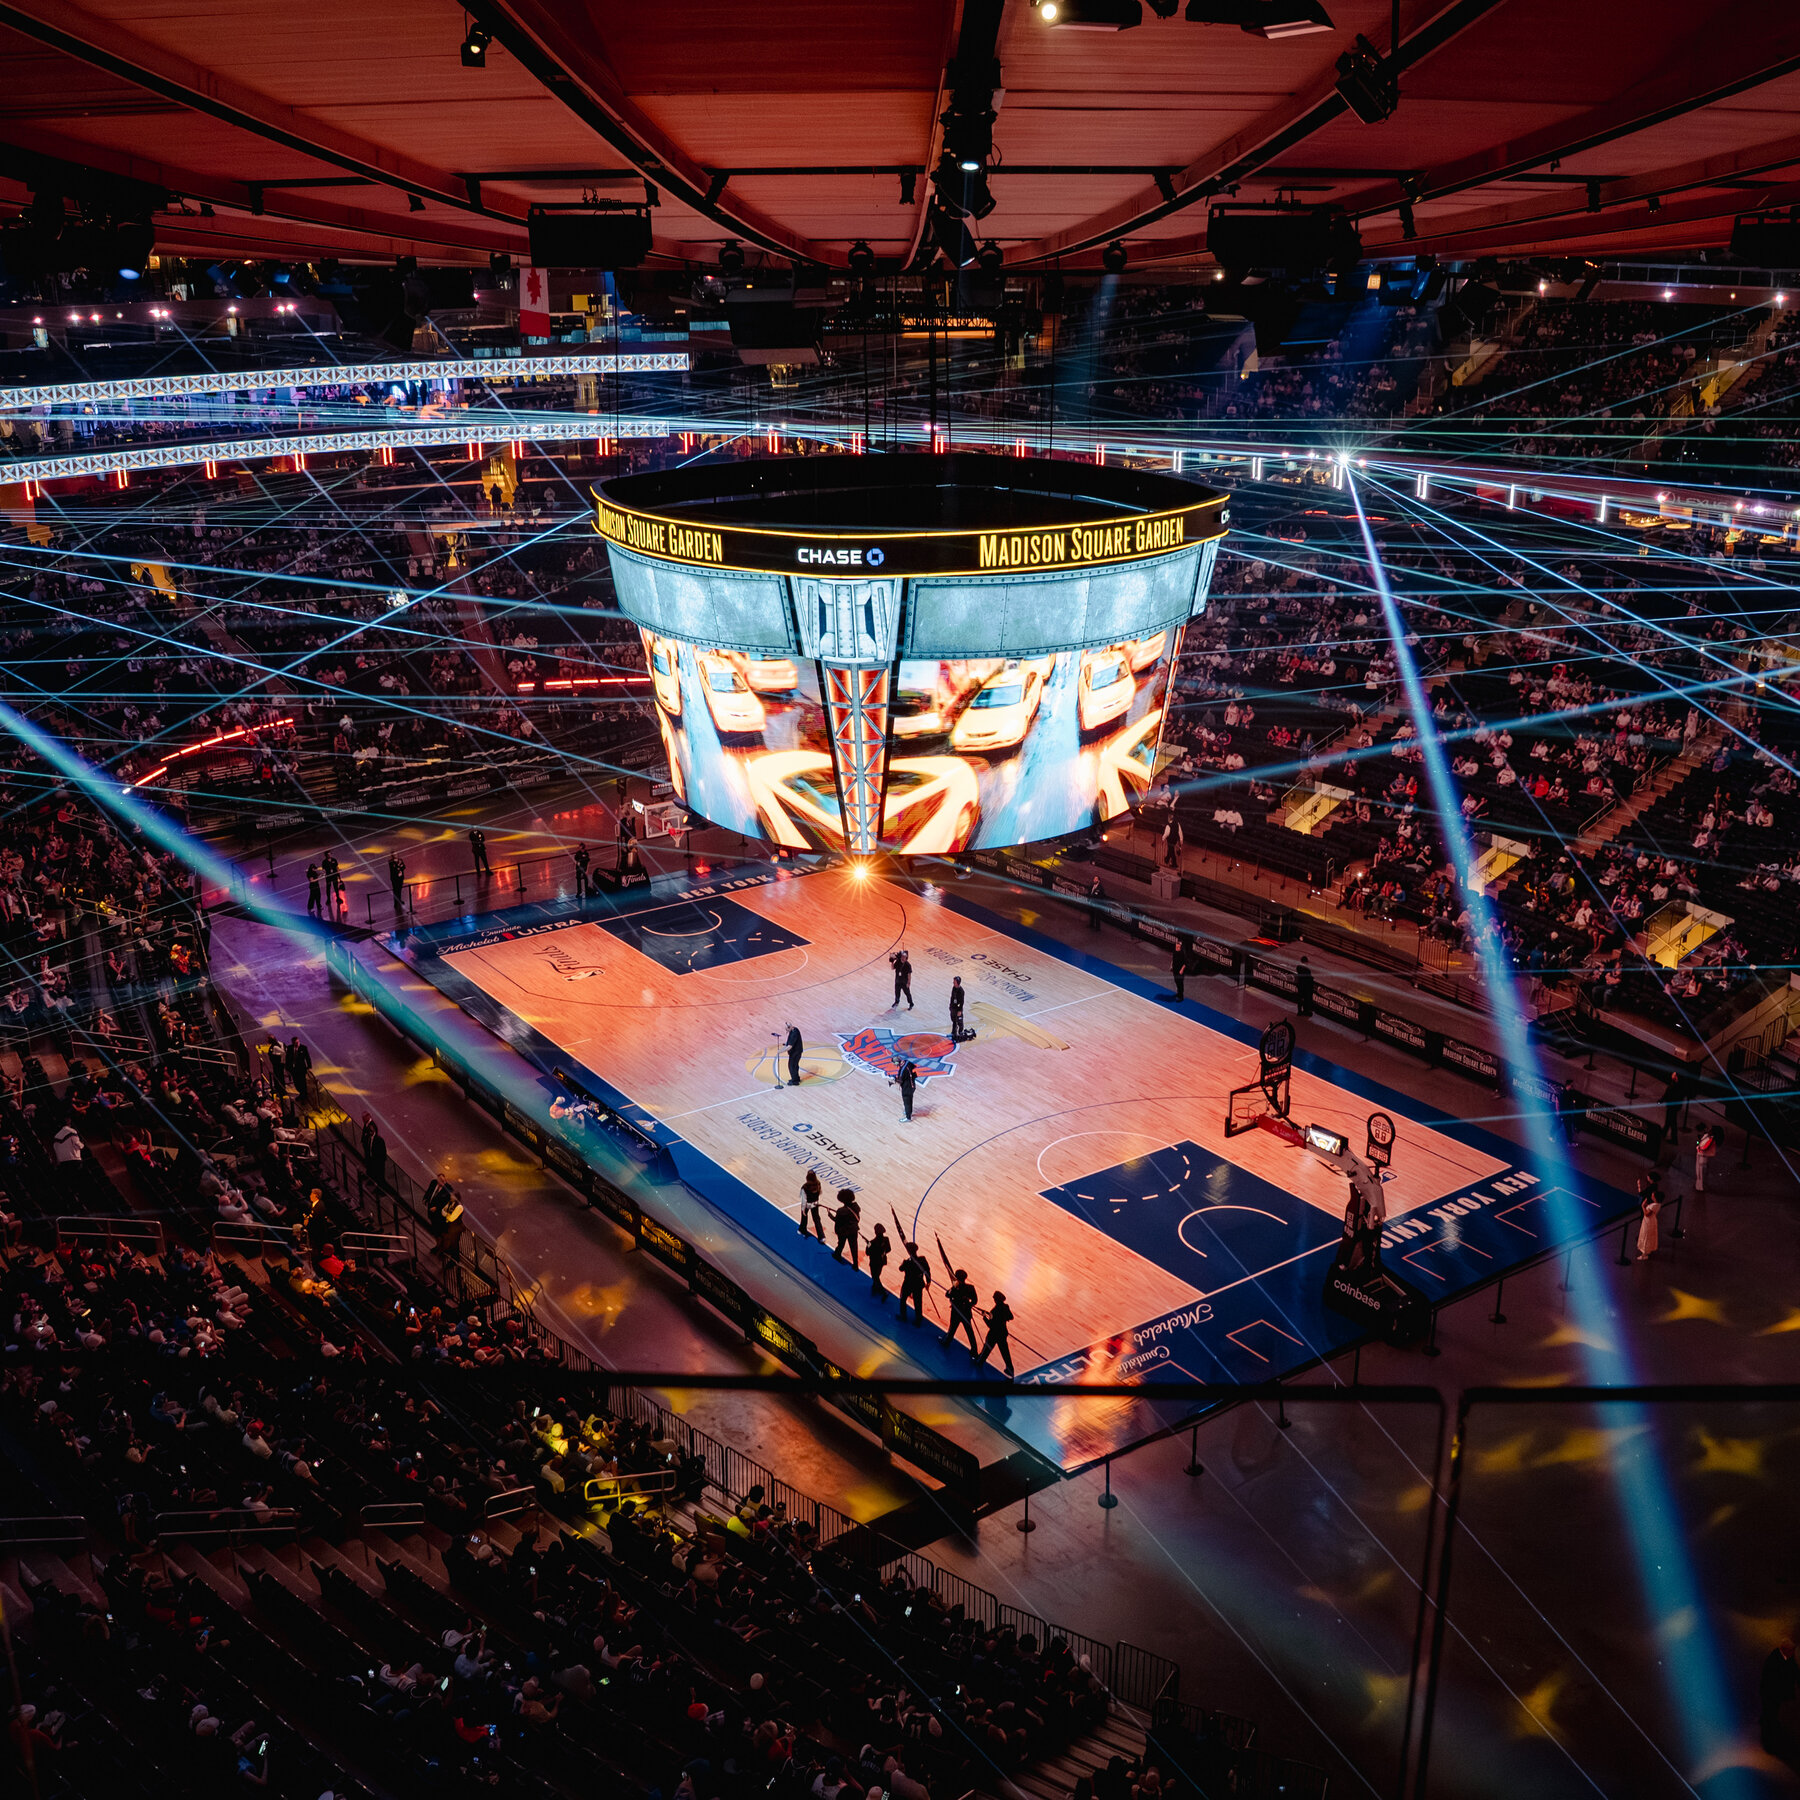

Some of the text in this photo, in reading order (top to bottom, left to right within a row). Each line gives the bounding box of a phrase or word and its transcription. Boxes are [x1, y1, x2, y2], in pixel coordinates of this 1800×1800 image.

[626, 515, 666, 552] SQUARE
[668, 523, 723, 562] GARDEN
[979, 534, 1065, 568] MADISON
[1071, 525, 1131, 560] SQUARE
[1136, 517, 1184, 551] GARDEN
[798, 548, 862, 565] CHASE
[677, 886, 716, 900] NEW
[720, 874, 773, 890] YORK
[436, 918, 583, 955] Michelob ULTRA
[983, 959, 1032, 982] CHASE
[737, 1112, 863, 1193] MADISON SQUARE GARDEN
[805, 1131, 862, 1166] CHASE
[1490, 1170, 1541, 1196] NEW
[1427, 1191, 1497, 1223] YORK
[1380, 1218, 1433, 1249] KNIC
[1334, 1279, 1381, 1311] coinbase
[1133, 1303, 1215, 1347] Michelob
